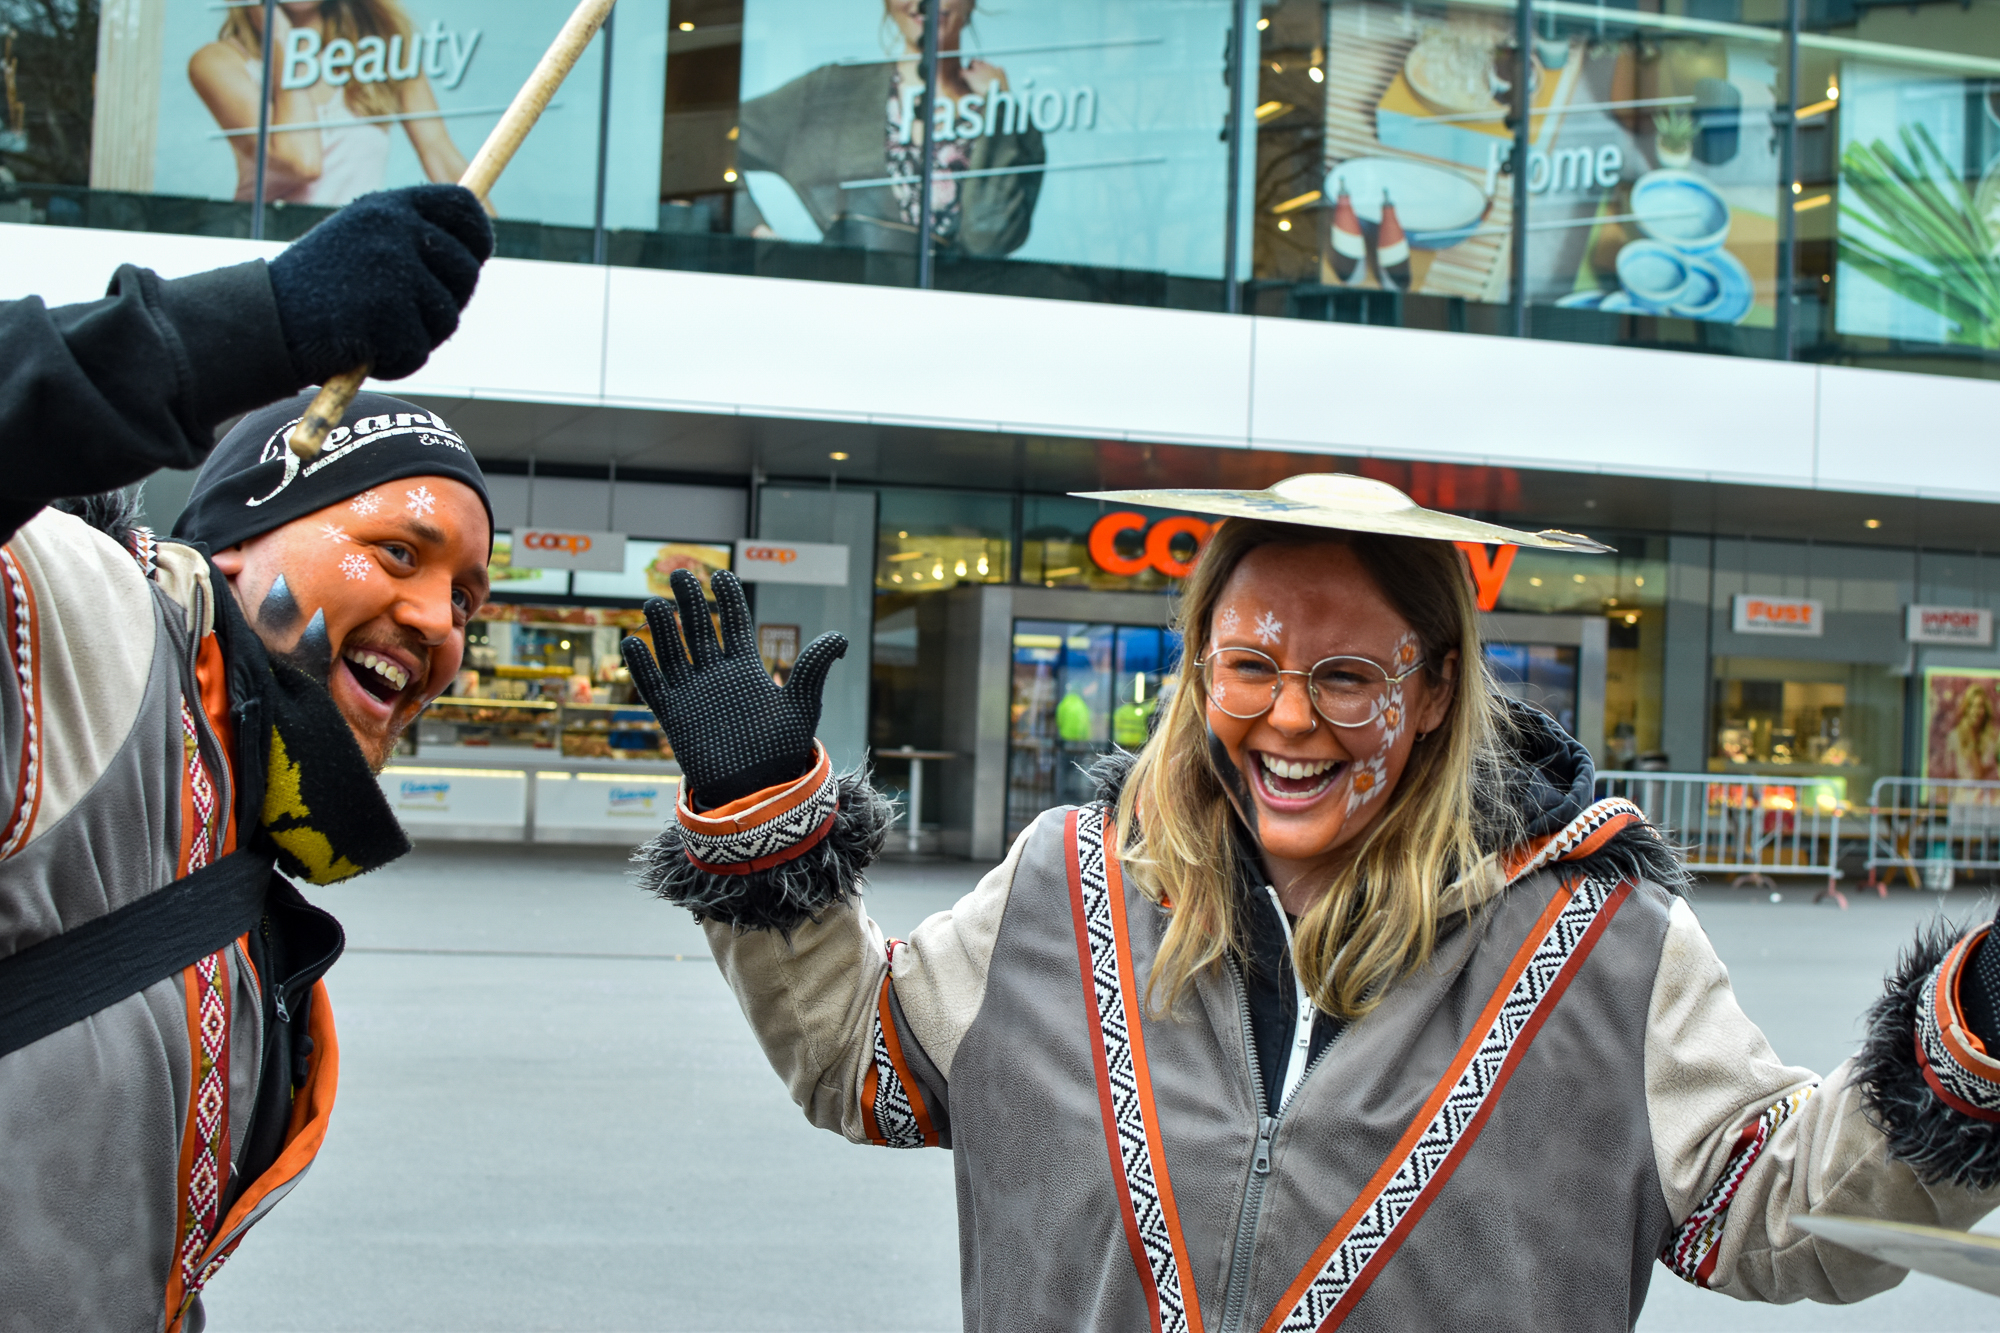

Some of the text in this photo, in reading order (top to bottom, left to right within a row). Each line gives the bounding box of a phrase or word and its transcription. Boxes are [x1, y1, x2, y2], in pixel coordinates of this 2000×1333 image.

[281, 20, 482, 90] Beauty
[899, 76, 1097, 145] Fashion
[523, 532, 592, 557] coop
[744, 544, 797, 566] coop
[1747, 601, 1813, 624] Fust
